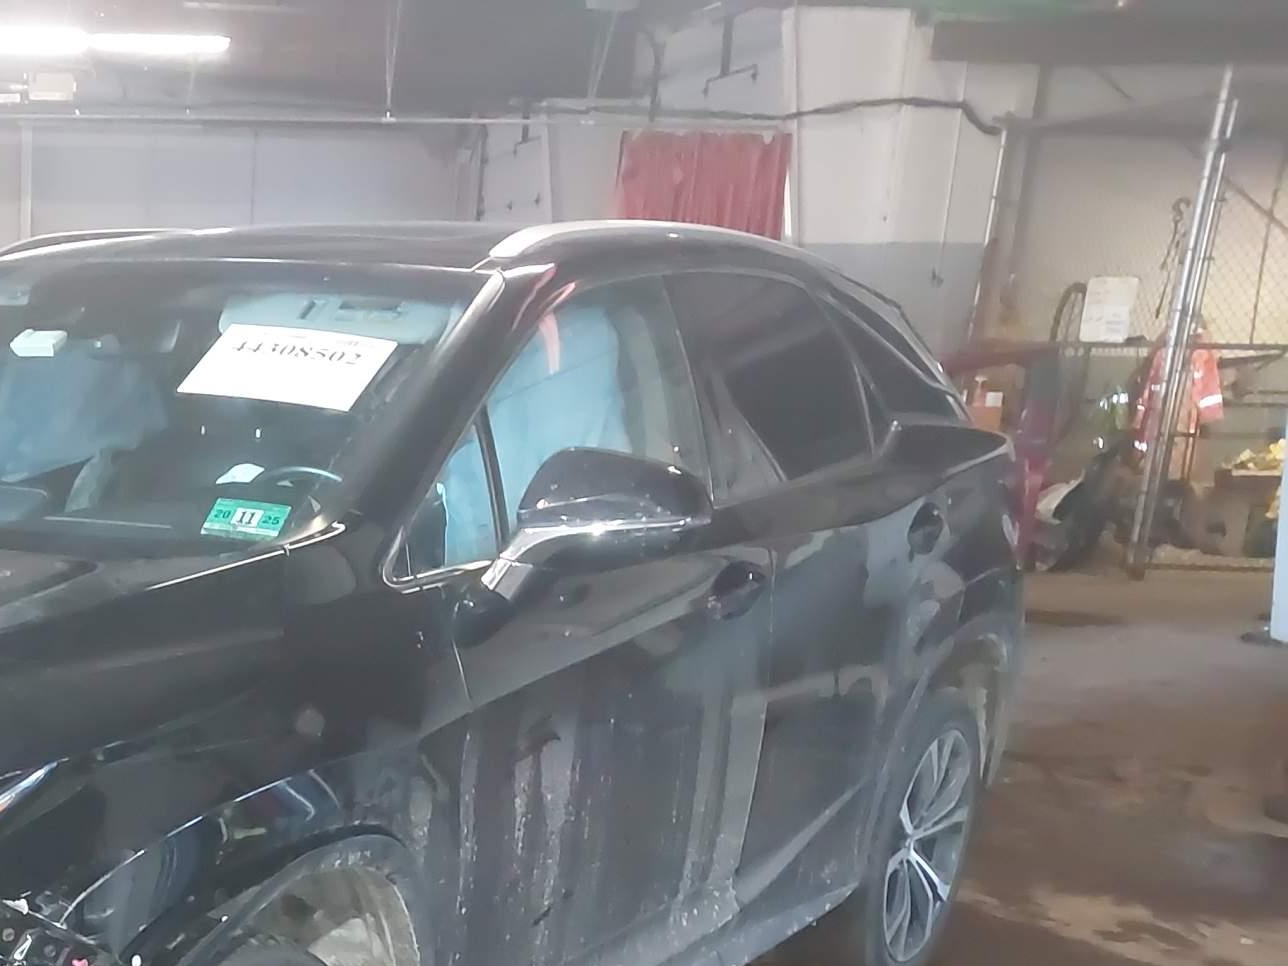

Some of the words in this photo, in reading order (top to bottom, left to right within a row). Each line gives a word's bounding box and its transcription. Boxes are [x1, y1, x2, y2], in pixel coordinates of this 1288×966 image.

[214, 509, 231, 519] 20
[237, 511, 256, 525] 11
[262, 515, 280, 525] 25
